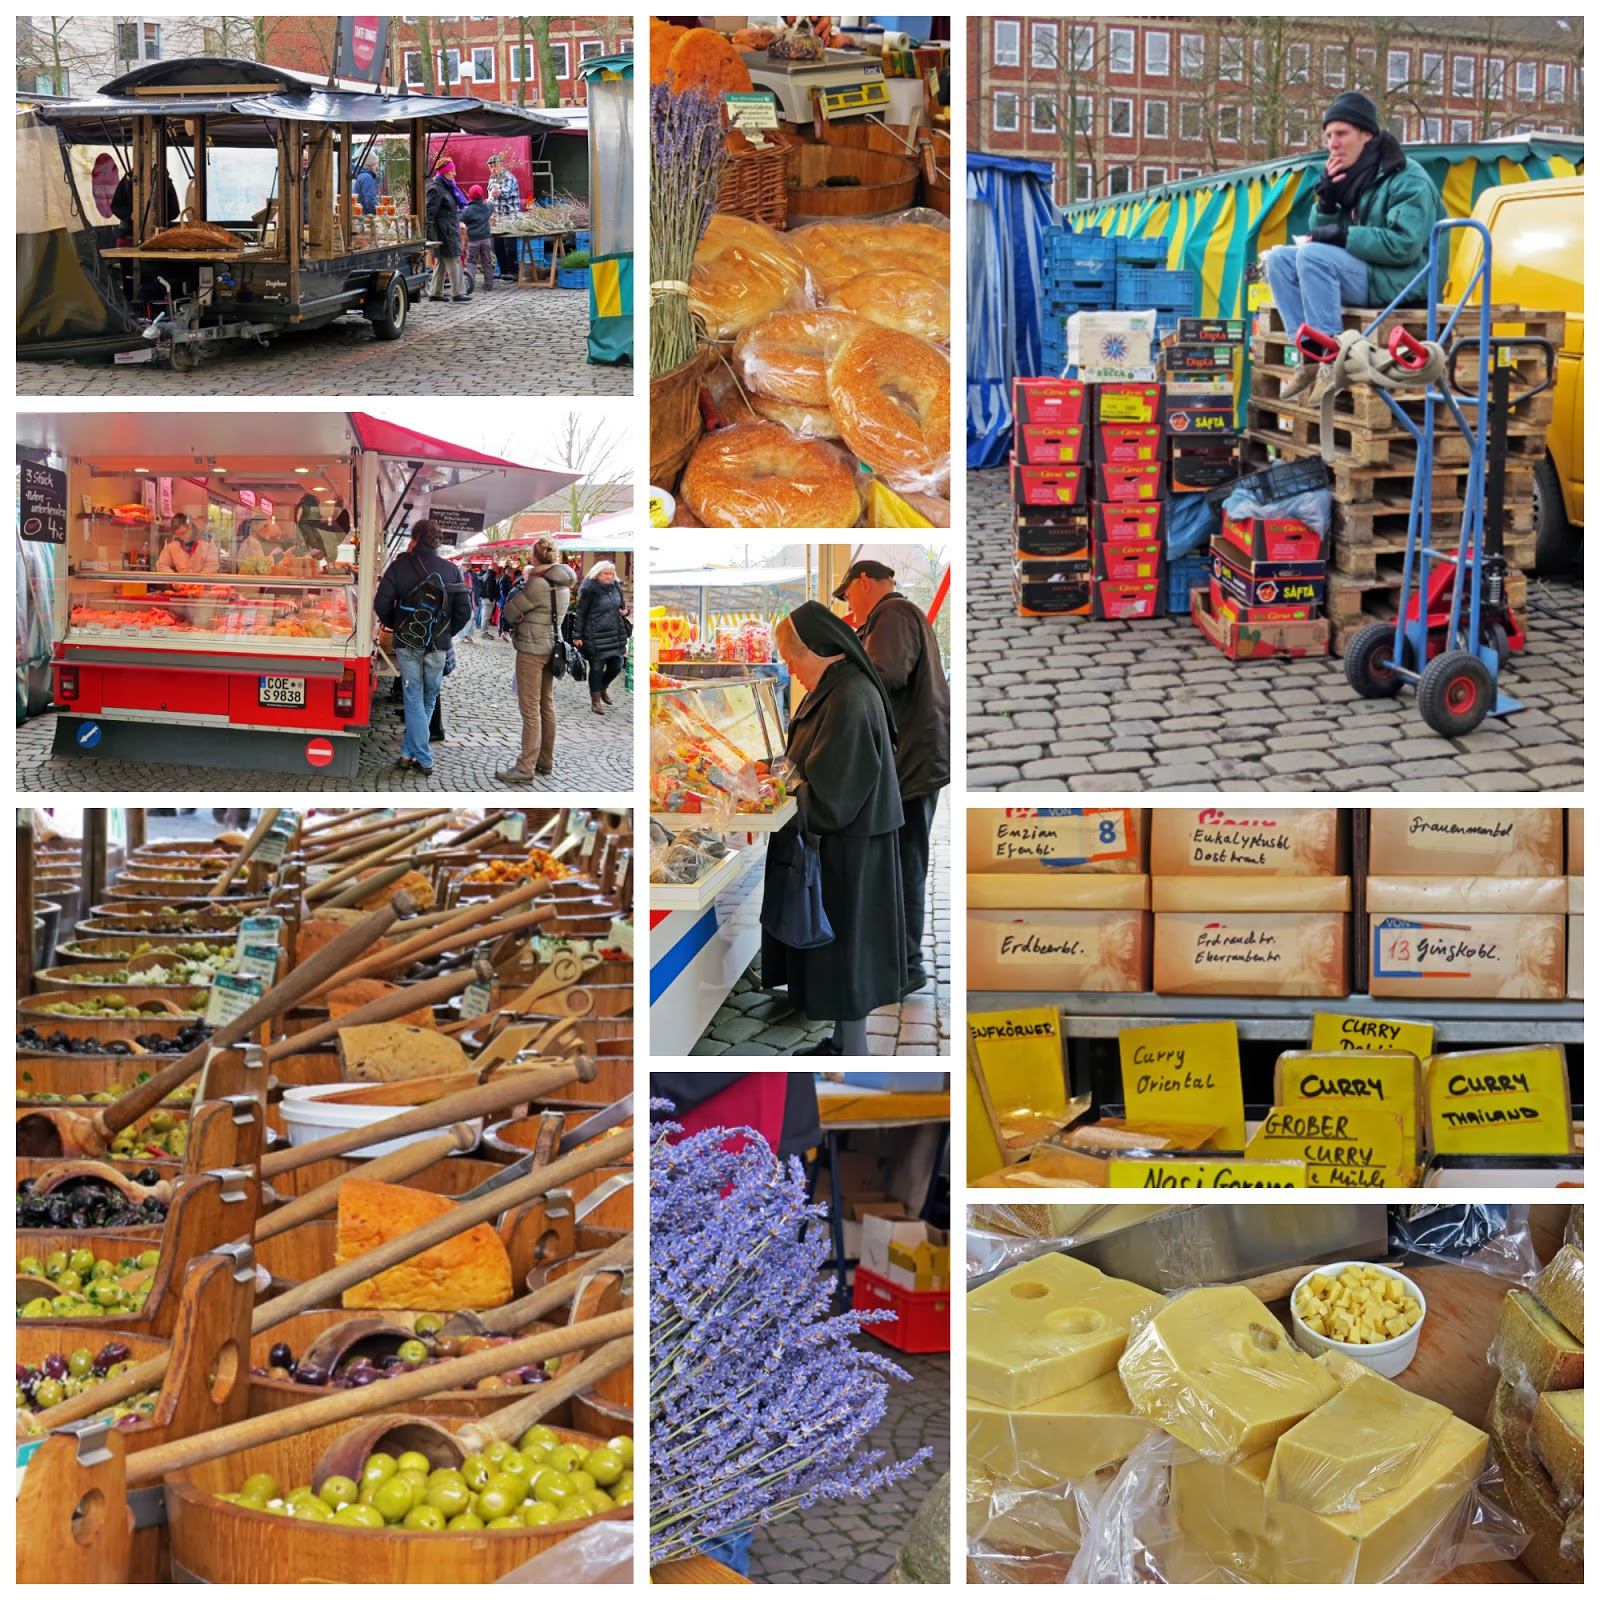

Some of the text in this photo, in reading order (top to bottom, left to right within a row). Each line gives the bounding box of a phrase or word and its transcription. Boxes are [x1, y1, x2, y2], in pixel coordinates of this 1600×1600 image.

[1194, 416, 1225, 430] SAFTA
[26, 469, 54, 488] 3 Stück
[1283, 584, 1315, 600] SAFTA
[267, 678, 289, 690] COE
[263, 690, 301, 702] S 9838
[997, 824, 1058, 840] Enzian
[1099, 820, 1117, 844] 8
[1387, 939, 1411, 961] 13
[1342, 1018, 1401, 1041] CURRY
[1134, 1045, 1185, 1071] Curry
[1137, 1071, 1215, 1095] Oriental
[1300, 1074, 1385, 1101] CURRY
[1448, 1073, 1530, 1096] CURRY
[1265, 1114, 1349, 1139] GROBER
[1304, 1144, 1374, 1167] CURRY
[1144, 1166, 1205, 1188] Nasi
